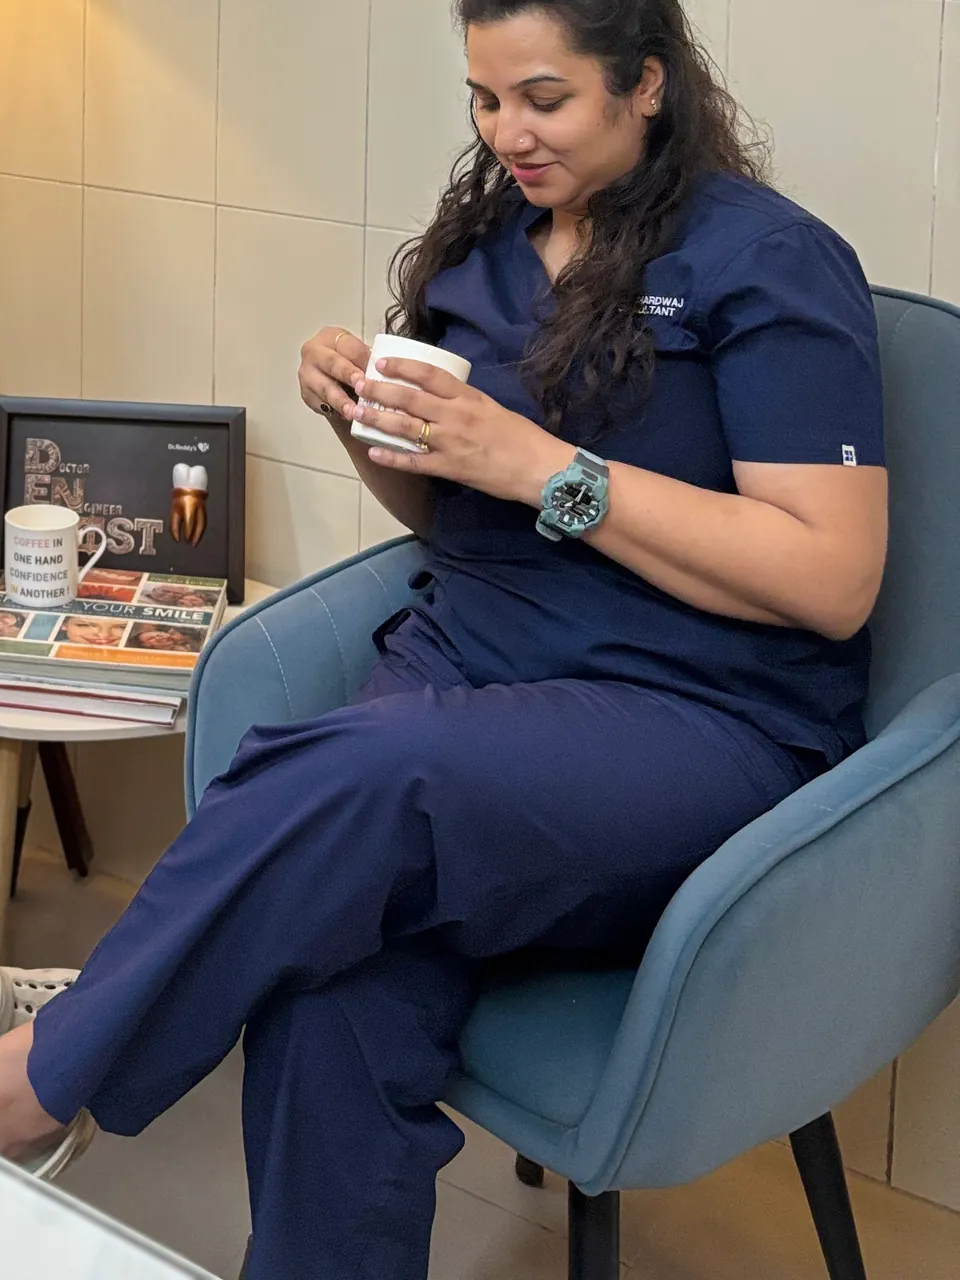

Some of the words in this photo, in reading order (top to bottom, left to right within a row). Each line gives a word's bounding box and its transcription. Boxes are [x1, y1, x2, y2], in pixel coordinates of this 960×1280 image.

[13, 536, 50, 548] COFFEE
[52, 537, 63, 548] IN
[13, 552, 32, 565] ONE
[34, 554, 63, 565] HAND
[9, 567, 68, 582] CONFIDENCE
[20, 587, 65, 599] ANOTHER
[82, 602, 136, 615] YOUR
[143, 608, 205, 620] SMILE
